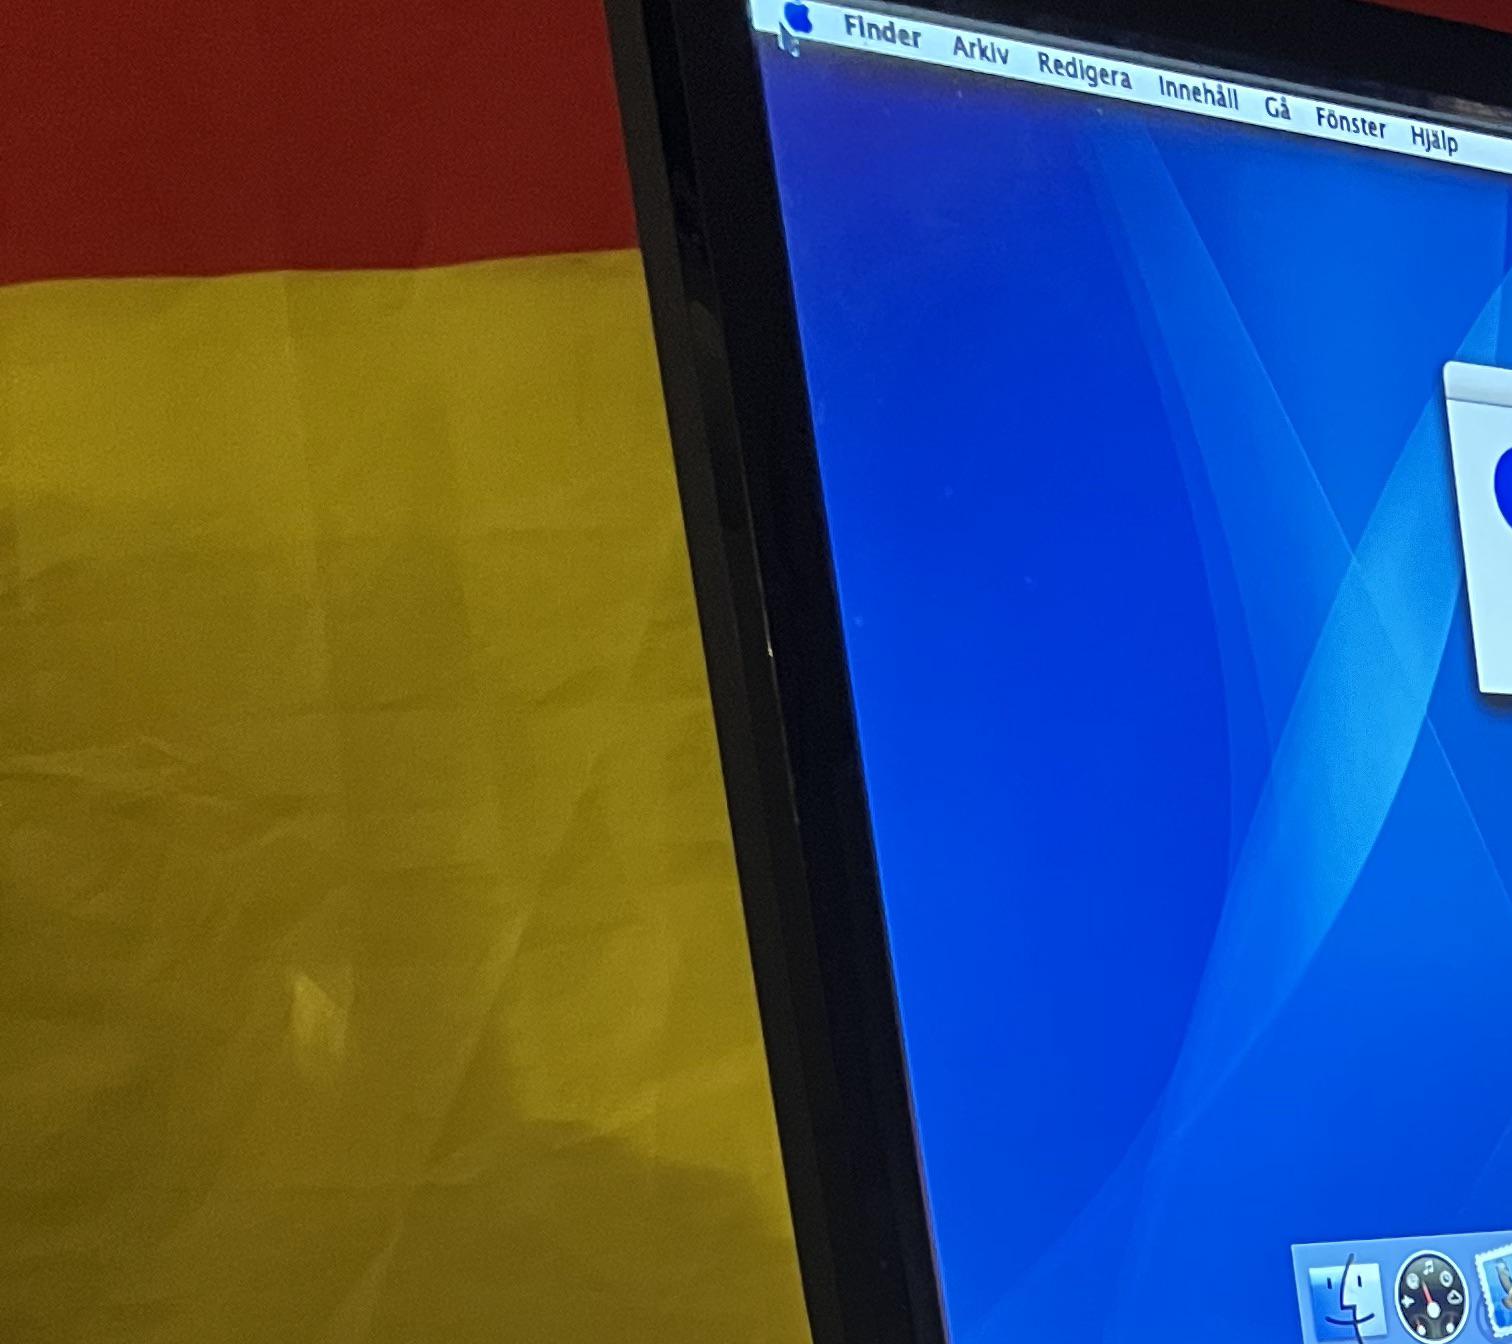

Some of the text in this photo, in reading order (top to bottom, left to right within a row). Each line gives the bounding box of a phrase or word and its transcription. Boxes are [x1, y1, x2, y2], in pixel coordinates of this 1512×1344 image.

[844, 14, 1458, 156] Finder Arkiv Redigera Innehåll Gå Fönster Hjälp
